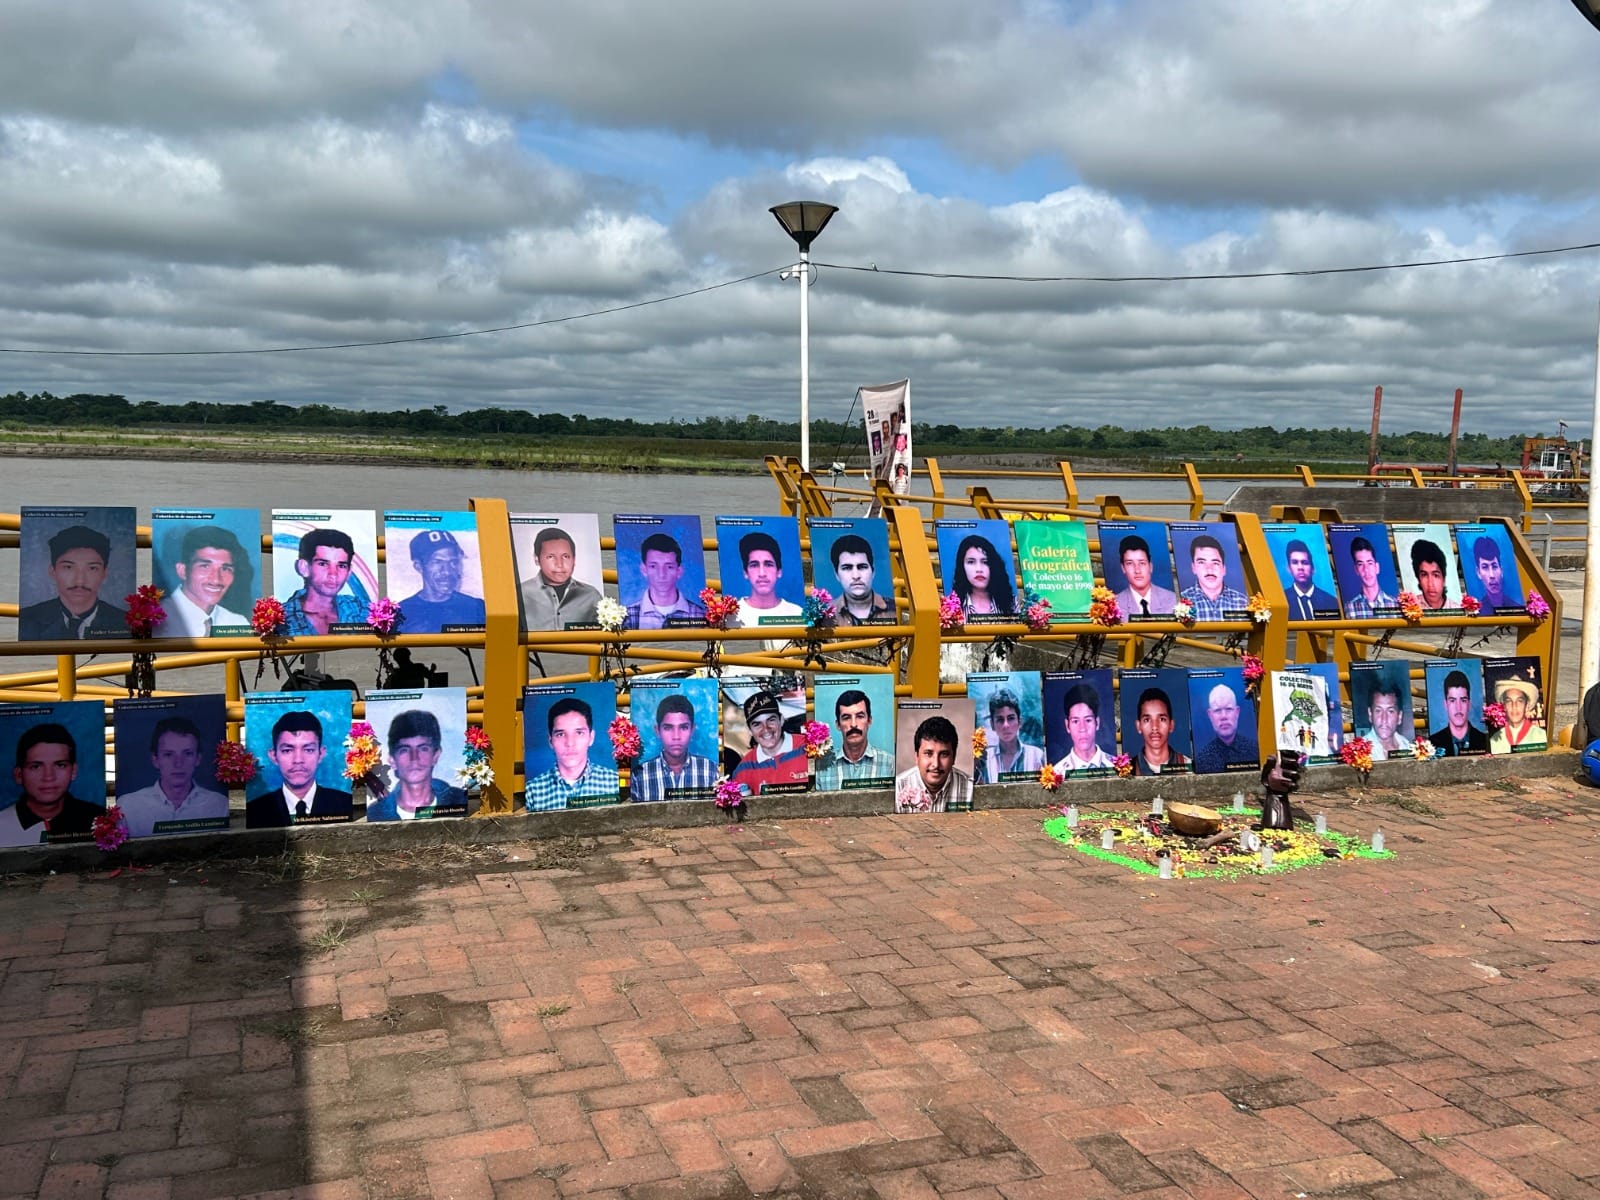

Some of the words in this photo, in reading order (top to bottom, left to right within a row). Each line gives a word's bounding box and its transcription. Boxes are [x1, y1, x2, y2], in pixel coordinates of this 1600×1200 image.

[1031, 545, 1077, 558] Galería
[1022, 558, 1090, 574] fotográfica
[1033, 572, 1073, 581] Colectivo
[1074, 573, 1083, 581] 16
[1025, 581, 1037, 591] de
[1038, 583, 1062, 592] mayo
[1063, 581, 1073, 590] de
